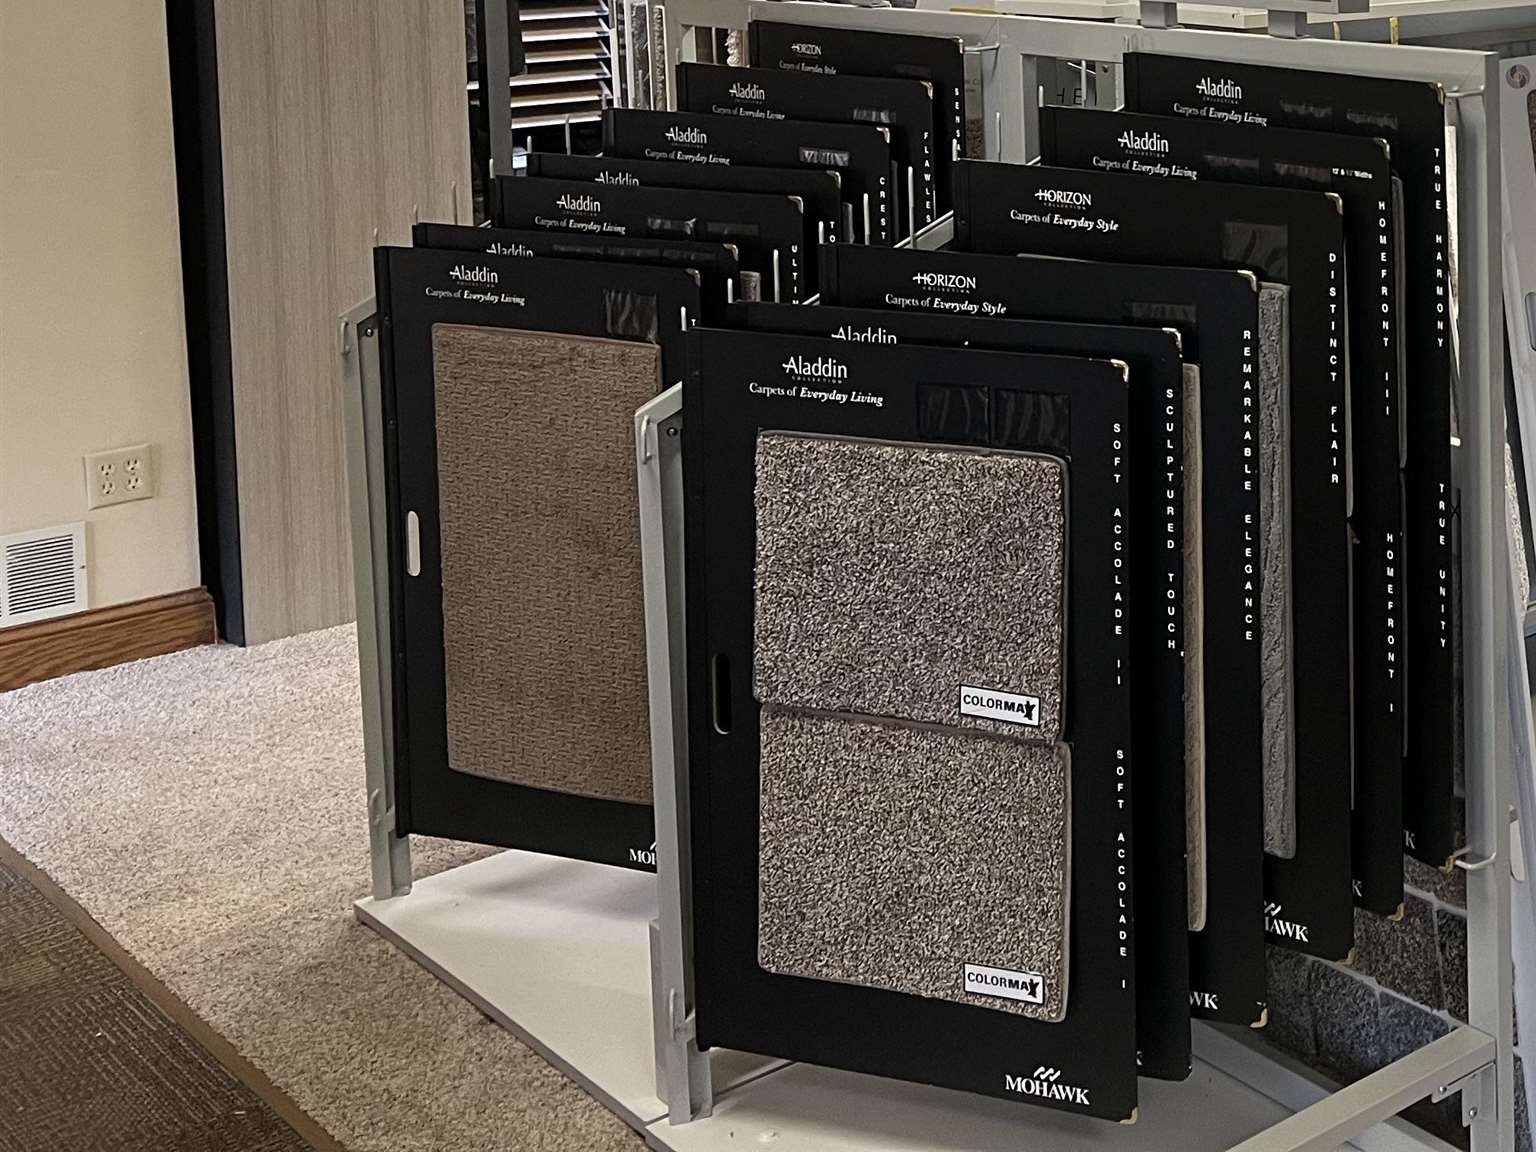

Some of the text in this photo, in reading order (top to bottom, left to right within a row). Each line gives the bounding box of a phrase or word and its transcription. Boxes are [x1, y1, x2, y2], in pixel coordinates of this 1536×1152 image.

[729, 82, 766, 100] Aladdin
[1195, 77, 1242, 99] Aladdin
[665, 126, 708, 144] Aladdin
[1117, 129, 1169, 153] Aladdin
[556, 194, 600, 213] Aladdin
[1034, 188, 1092, 206] HORIZON
[1010, 209, 1119, 233] Carpets of Everyday Style
[1433, 147, 1444, 348] TRUE HARMONY
[450, 264, 499, 284] Aladdin
[912, 272, 977, 289] HORIZON
[1378, 200, 1390, 348] HOMEFRONT
[425, 286, 452, 299] Carpets
[463, 290, 500, 305] Everyday
[500, 293, 526, 307] Living
[885, 293, 1007, 316] Carpets of Everyday Style
[831, 325, 898, 345] Aladdin
[782, 355, 848, 379] Aladdin
[1328, 252, 1339, 485] DISTINCT FLAIR
[749, 382, 884, 408] Carpets of Everyday Living
[1113, 422, 1122, 484] SOFT
[1242, 330, 1253, 641] REMARKABLE ELEGANCE
[1165, 388, 1176, 650] SCULPTURED TOUCH
[1113, 507, 1123, 636] ACCOLADE
[1438, 483, 1447, 648] TRUE UNITY
[1386, 532, 1395, 680] HOMEFRONT
[1116, 749, 1125, 810] SOFT
[1117, 832, 1128, 957] ACCOLADE
[1005, 1074, 1091, 1106] MOHAWK
